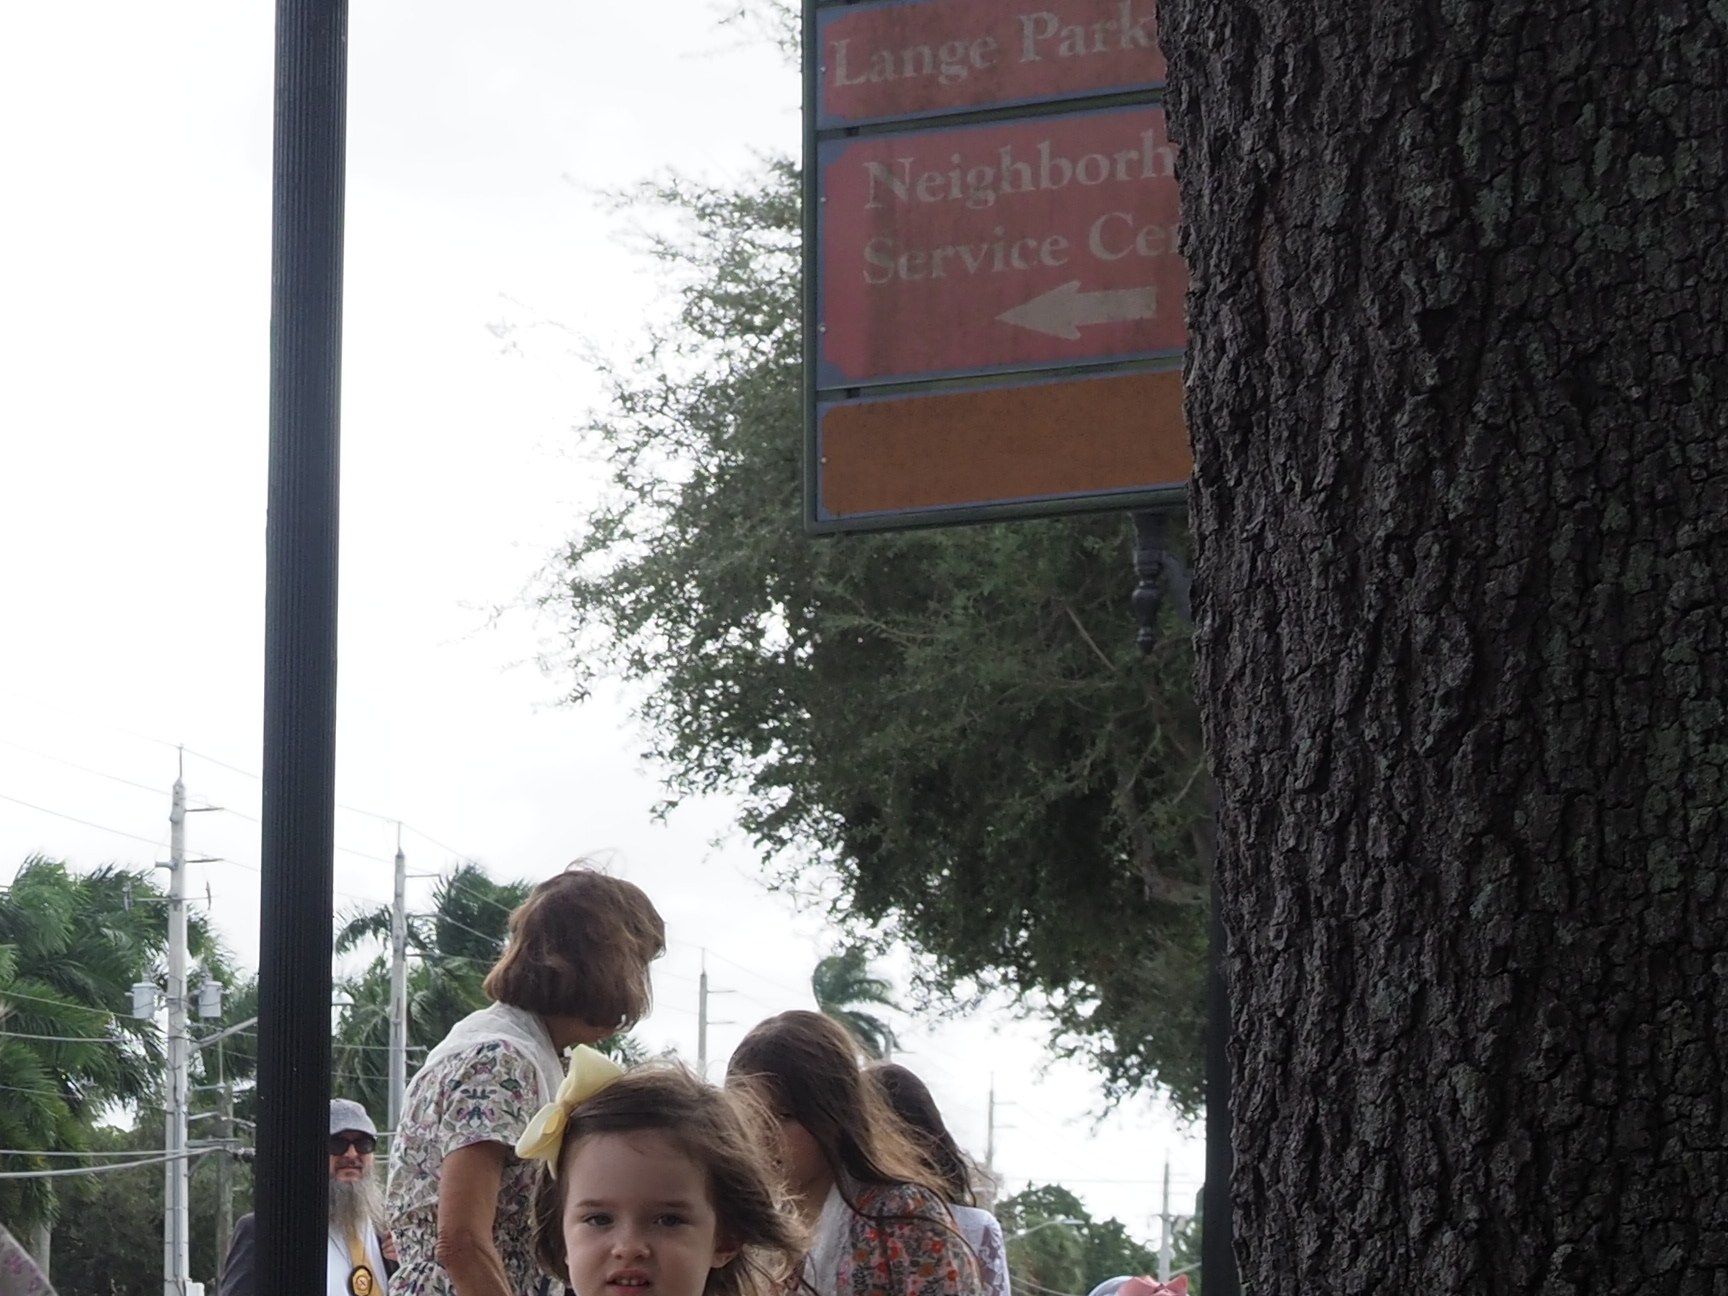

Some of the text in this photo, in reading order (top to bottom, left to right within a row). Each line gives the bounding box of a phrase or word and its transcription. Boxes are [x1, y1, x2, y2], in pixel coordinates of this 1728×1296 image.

[830, 0, 1157, 87] Lange Park
[863, 226, 1070, 285] Service
